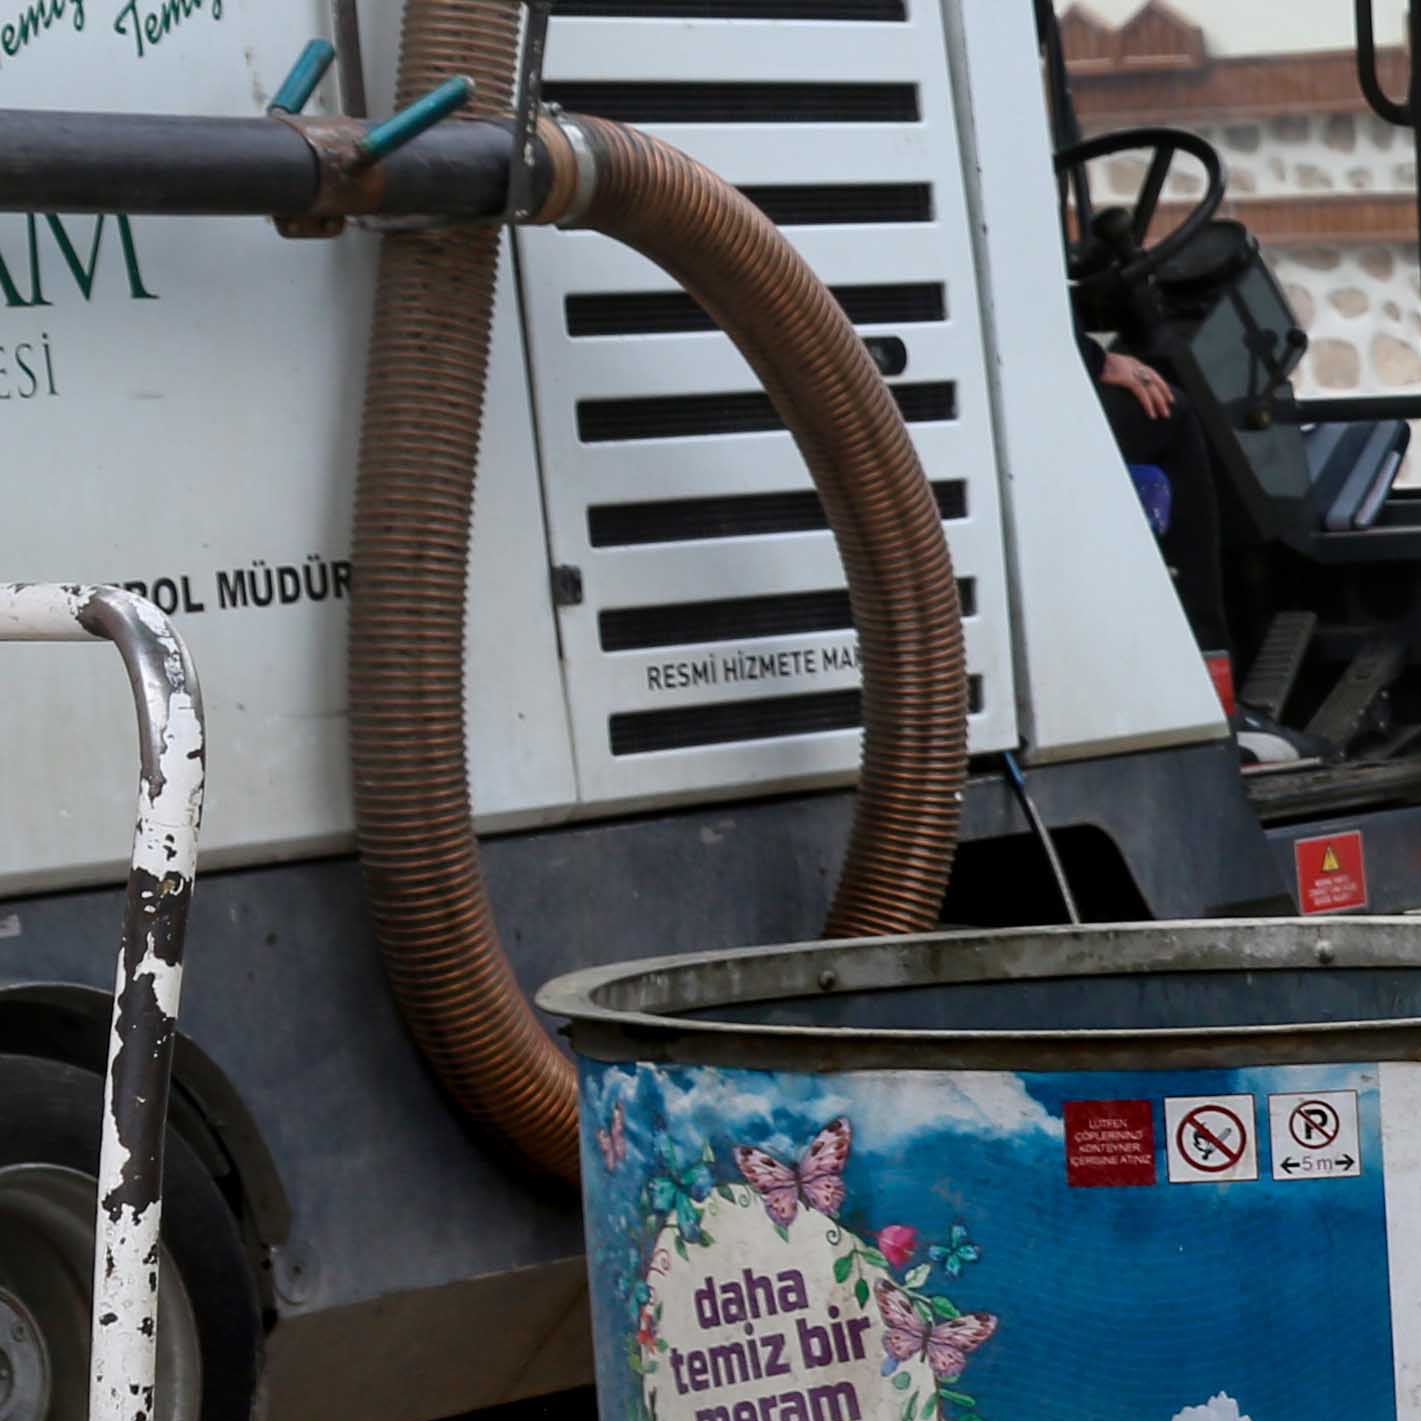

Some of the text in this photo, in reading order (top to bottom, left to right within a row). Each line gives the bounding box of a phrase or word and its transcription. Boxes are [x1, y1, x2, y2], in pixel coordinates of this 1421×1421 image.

[647, 653, 718, 690] RESMİ
[723, 649, 817, 682] HİZMETE
[1302, 1156, 1333, 1171] 5 m
[694, 1268, 809, 1330] daha
[670, 1305, 871, 1395] temiz bir
